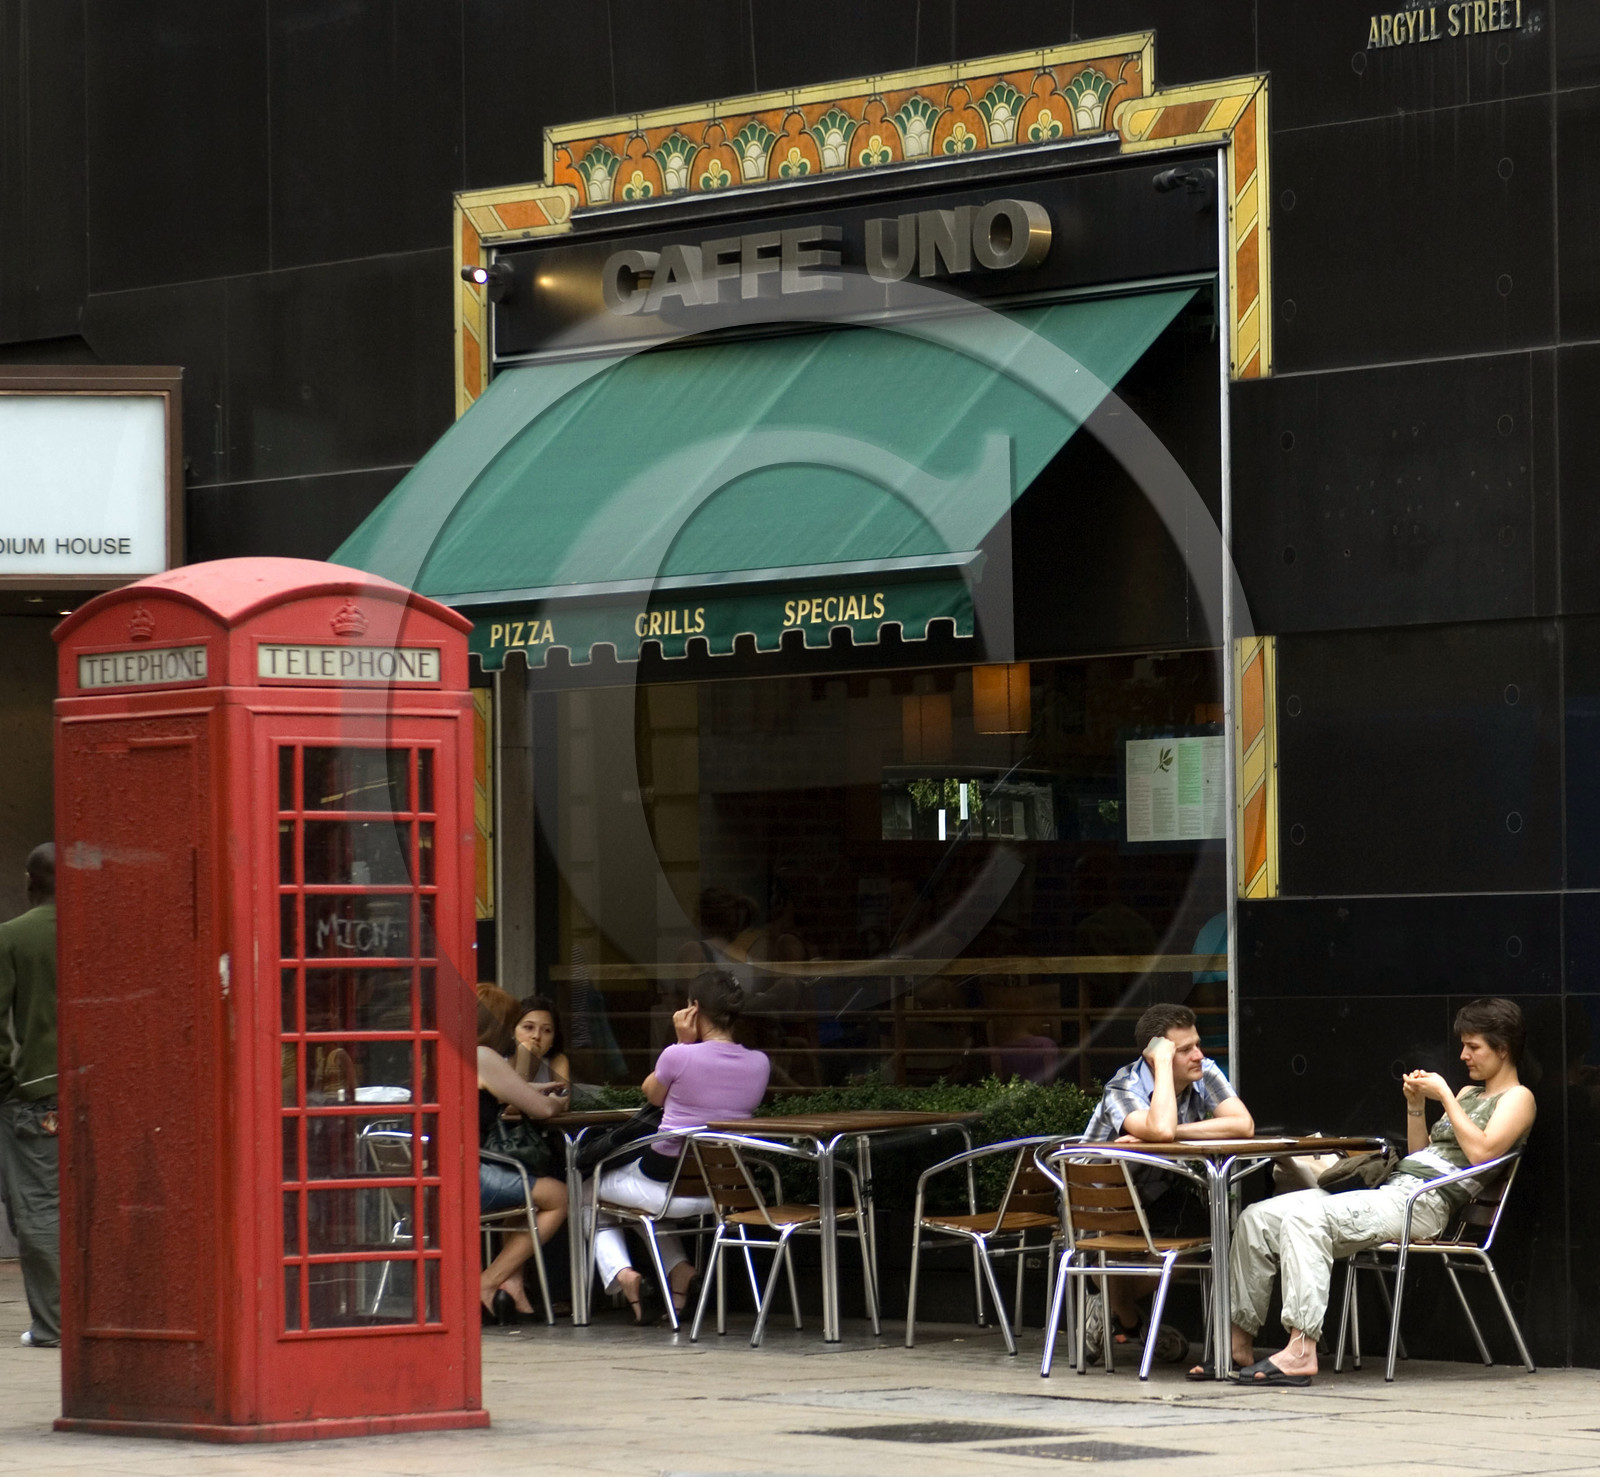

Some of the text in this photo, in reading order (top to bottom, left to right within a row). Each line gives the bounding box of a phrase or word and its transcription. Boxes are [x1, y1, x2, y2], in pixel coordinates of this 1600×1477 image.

[1366, 0, 1523, 50] ARGYLL STREET
[602, 199, 1052, 316] CAFFE UNO
[55, 537, 132, 555] HOUSE
[490, 592, 886, 648] PIZZA GRILLS SPECIALS
[85, 650, 206, 686] TELEPHONE
[265, 647, 432, 679] TELEPHONE
